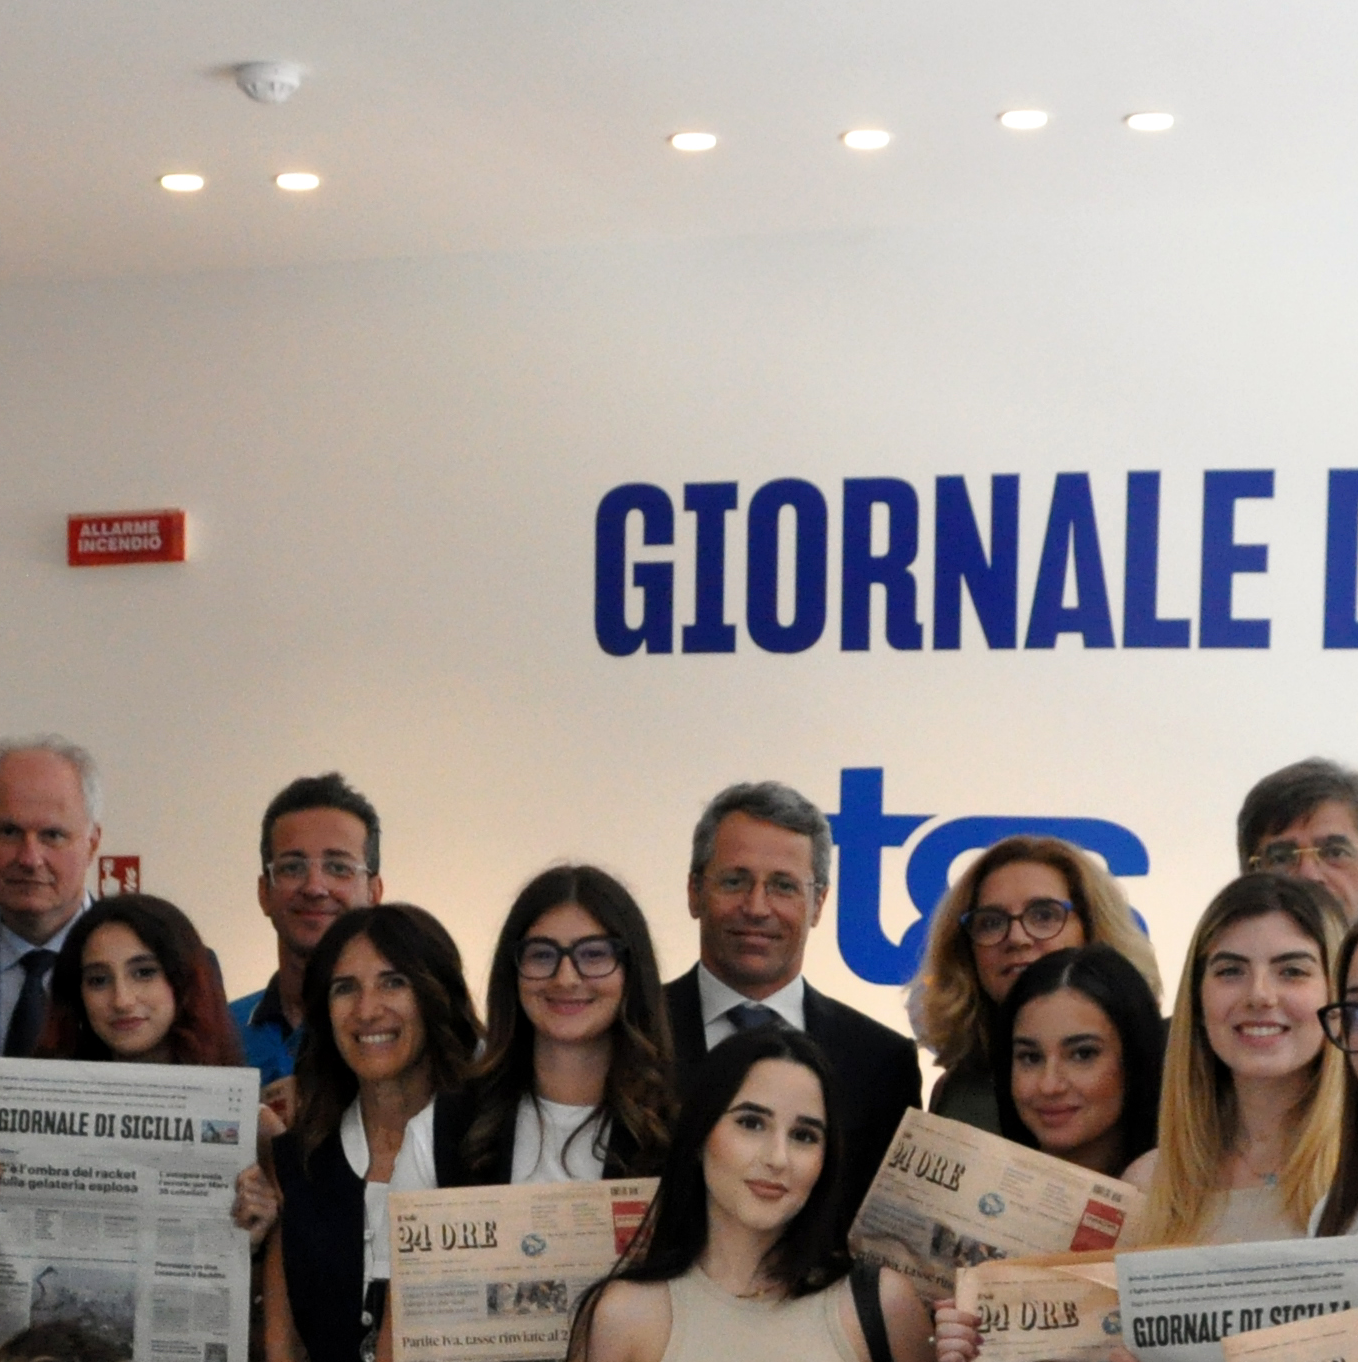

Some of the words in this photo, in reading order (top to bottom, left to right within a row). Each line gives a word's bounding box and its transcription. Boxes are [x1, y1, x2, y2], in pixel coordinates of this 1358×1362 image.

[78, 535, 163, 552] INCENDIO
[80, 520, 160, 536] ALLARME
[593, 467, 1276, 657] GIORNALE
[94, 1113, 115, 1138] DI
[121, 1114, 194, 1142] SICILIA
[915, 1152, 966, 1192] ORE
[398, 1224, 432, 1252] 24
[441, 1221, 498, 1250] ORE
[979, 1304, 1010, 1333] 24
[1020, 1301, 1080, 1332] ORE
[1133, 1310, 1233, 1348] GIORNALE
[402, 1334, 440, 1348] Partite
[548, 1330, 559, 1342] al
